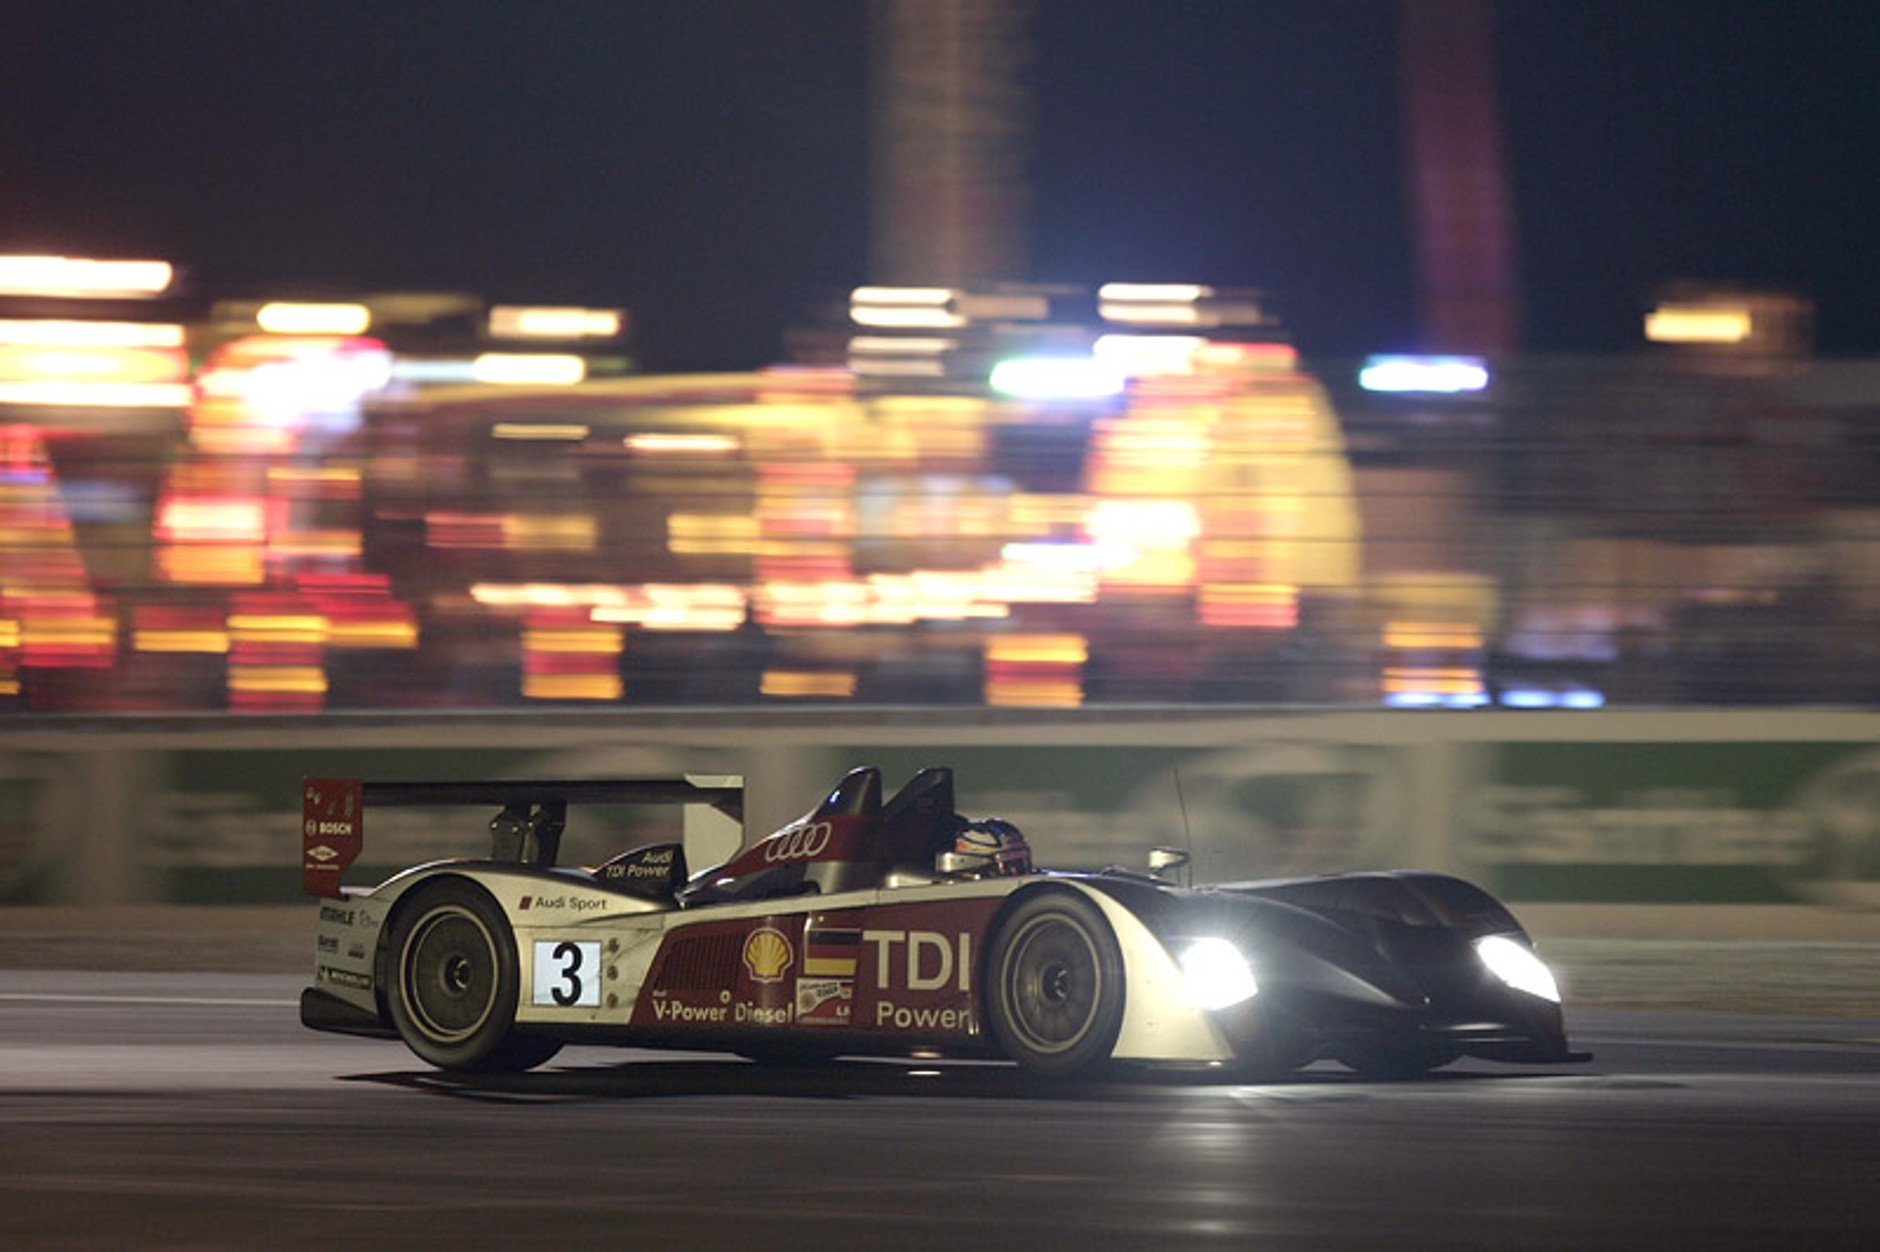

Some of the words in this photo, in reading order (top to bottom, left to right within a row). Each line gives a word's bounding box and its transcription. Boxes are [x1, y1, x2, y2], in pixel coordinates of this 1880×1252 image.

[642, 851, 673, 863] Audi
[628, 865, 669, 878] Power
[536, 897, 566, 909] Audi
[571, 897, 607, 912] Sport
[862, 930, 971, 992] TDI
[551, 941, 583, 1007] 3
[652, 1000, 728, 1021] V-Power
[735, 1001, 794, 1023] Diesel
[876, 1001, 970, 1029] Power
